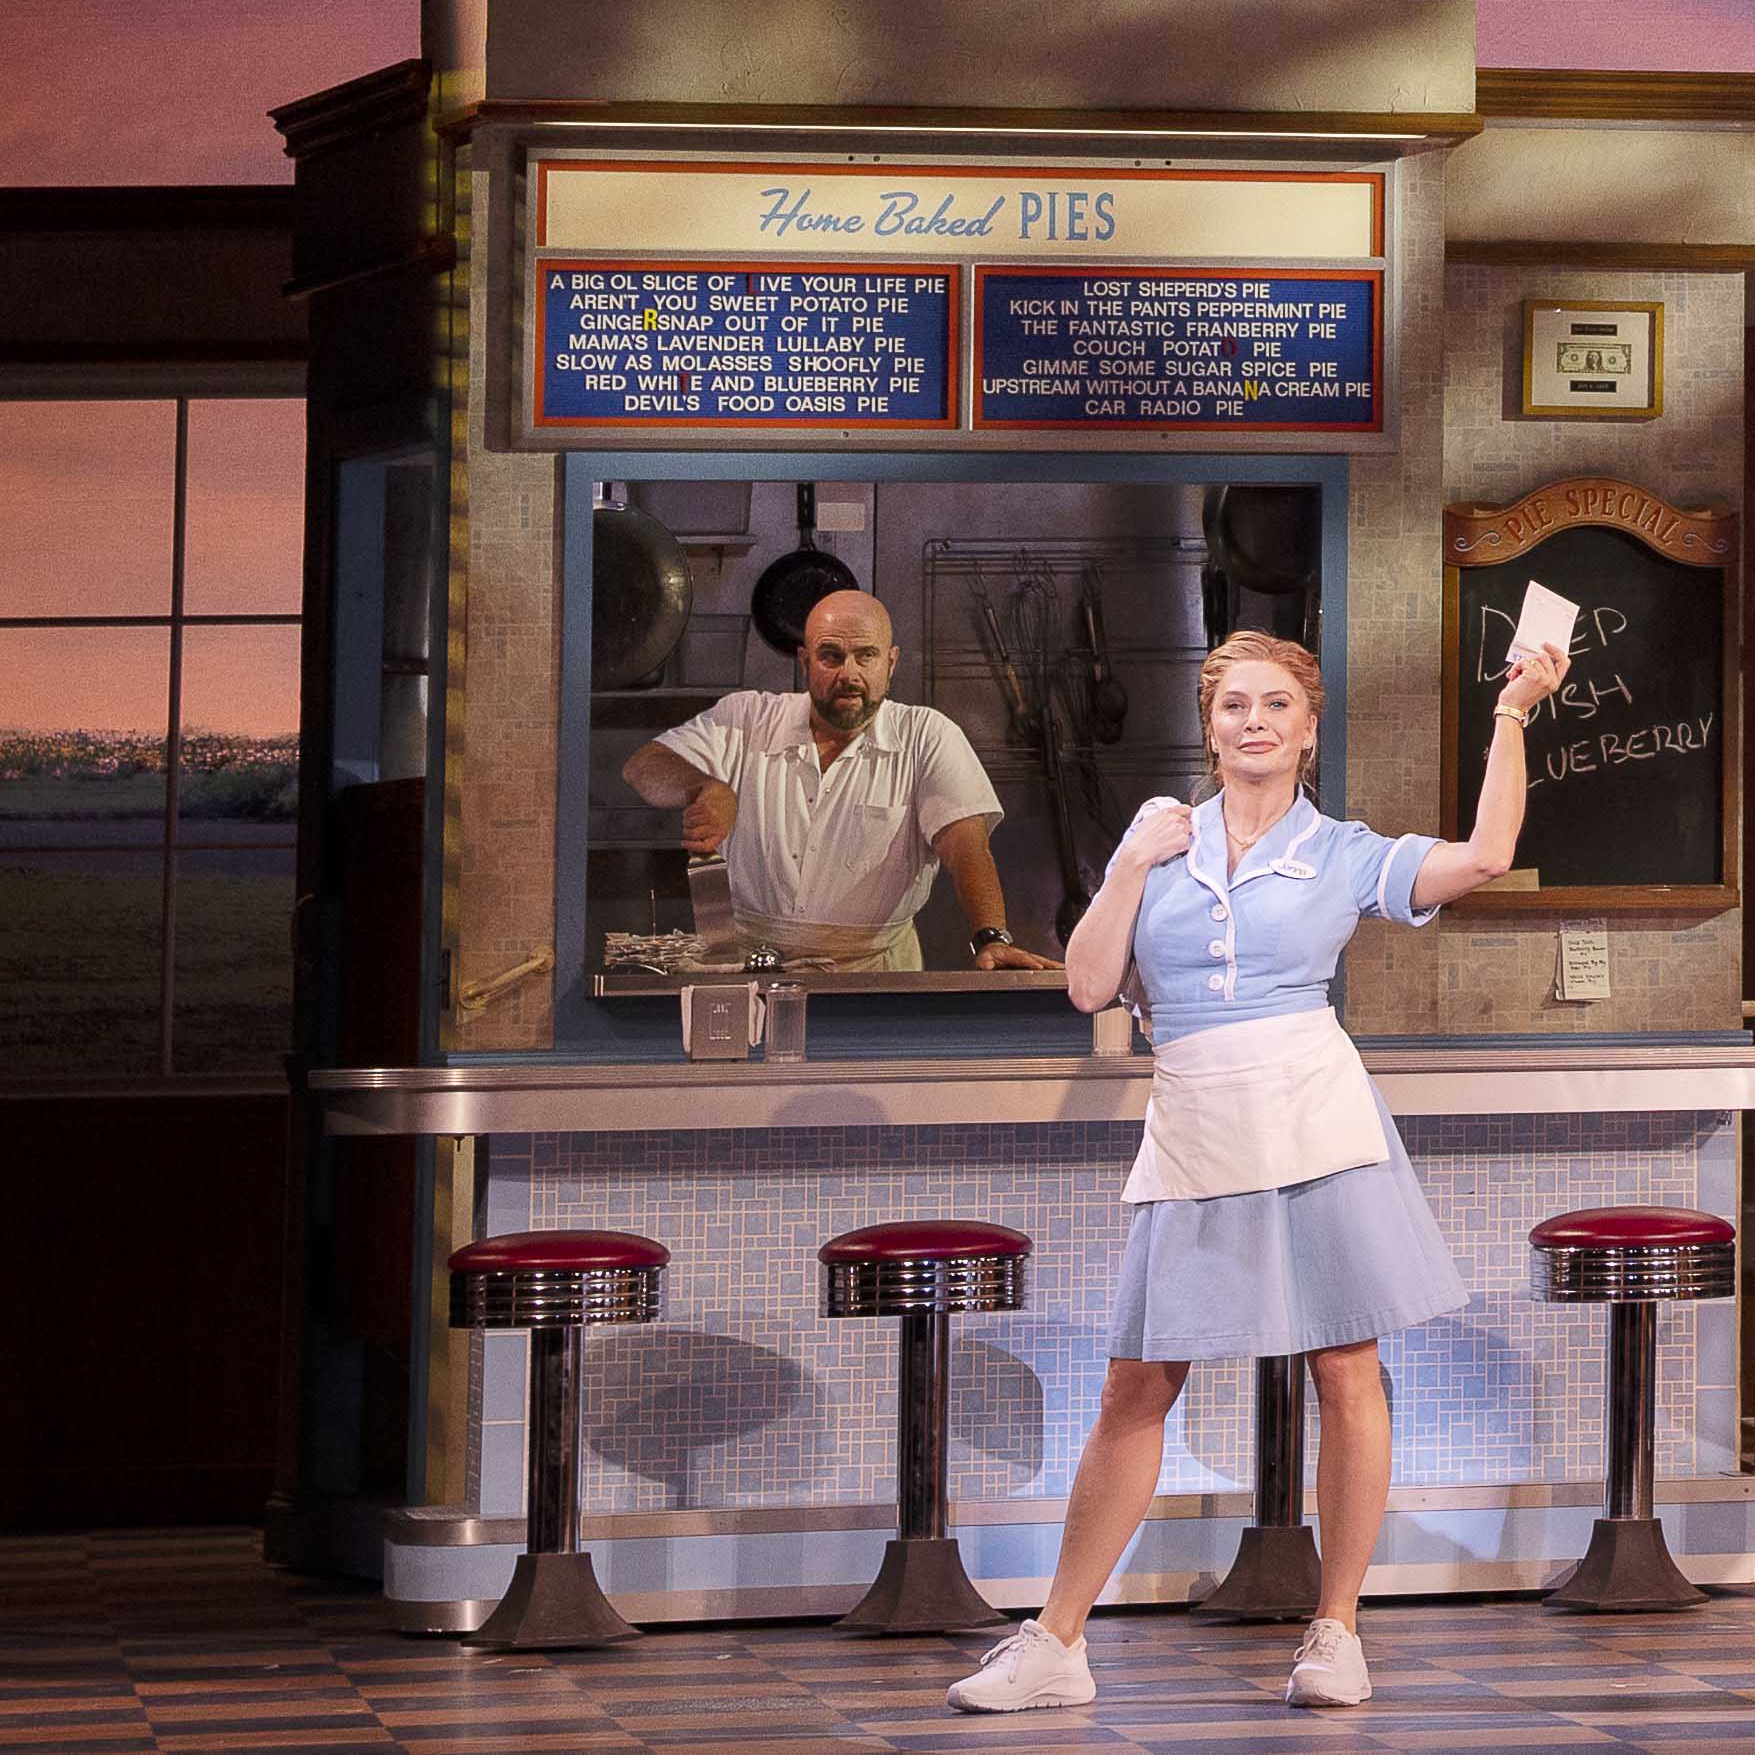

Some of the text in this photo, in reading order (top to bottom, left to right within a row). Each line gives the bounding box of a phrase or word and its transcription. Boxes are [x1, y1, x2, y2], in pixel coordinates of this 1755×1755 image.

[759, 188, 1115, 241] Home Baked PIES
[551, 275, 564, 289] A
[572, 275, 604, 289] BIG
[611, 275, 637, 290] OL
[643, 275, 697, 291] SLICE
[708, 276, 735, 291] OF
[802, 277, 856, 292] YOUR
[866, 278, 905, 293] LIFE
[915, 279, 944, 293] PIE
[1084, 281, 1270, 298] LOST SHEPERD'S PIE
[570, 294, 908, 313] AREN'T YOU SWEET POTATO PIE
[1011, 300, 1346, 318] KICK IN THE PANTS PEPPERMINT PIE
[581, 309, 883, 332] GINGERSNAP OUT OF IT PIE
[1022, 321, 1336, 338] THE FANTASTIC FRANBERRY PIE
[570, 334, 905, 352] MAMA'S LAVENDER LULLABY PIE
[1074, 341, 1145, 355] COUCH
[1254, 342, 1281, 357] PIE
[557, 354, 924, 373] SLOW AS MOLASSES SHOOFLY PIE
[1024, 360, 1337, 377] GIMME SOME SUGAR SPICE PIE
[586, 375, 626, 390] RED
[711, 376, 754, 391] AND
[765, 376, 878, 392] BLUEBERRY
[890, 377, 919, 392] PIE
[983, 379, 1370, 401] UPSTREAM WITHOUT A BANANA CREAM PIE
[625, 395, 888, 412] DEVIL'S FOOD OASIS PIE
[1086, 400, 1243, 415] CAR RADIO PIE
[1505, 488, 1680, 546] PIE SPECIAL
[1477, 605, 1628, 682] DEP
